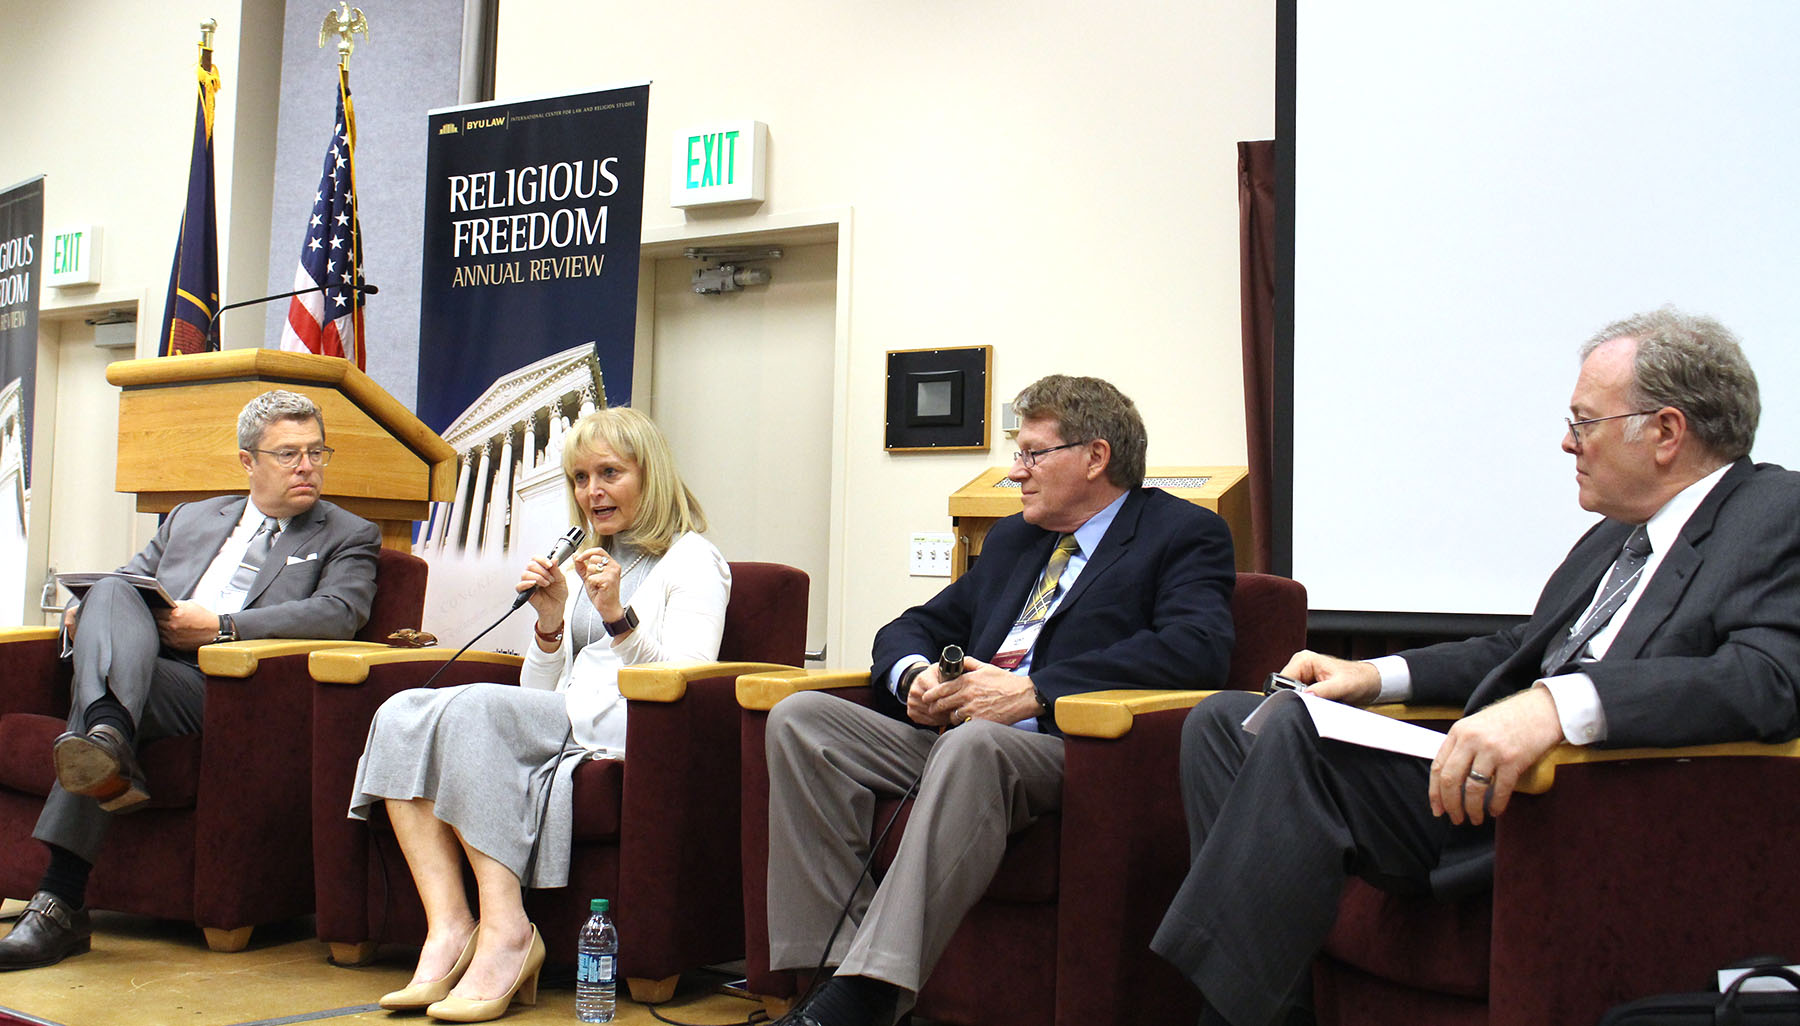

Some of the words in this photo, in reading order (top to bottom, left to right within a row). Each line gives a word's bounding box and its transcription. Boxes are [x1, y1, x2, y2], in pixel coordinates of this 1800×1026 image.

[466, 120, 485, 130] BYU
[485, 117, 506, 127] LAW
[510, 113, 544, 121] INTERNATIONAL
[545, 110, 562, 118] CENTER
[594, 103, 615, 111] RELIGION
[686, 130, 740, 189] EXIT
[448, 157, 619, 213] RELIGIOUS
[452, 206, 608, 258] FREEDOM
[53, 232, 83, 274] EXIT
[452, 261, 525, 288] ANNUAL
[529, 254, 605, 282] REVIEW
[0, 272, 30, 308] DOM
